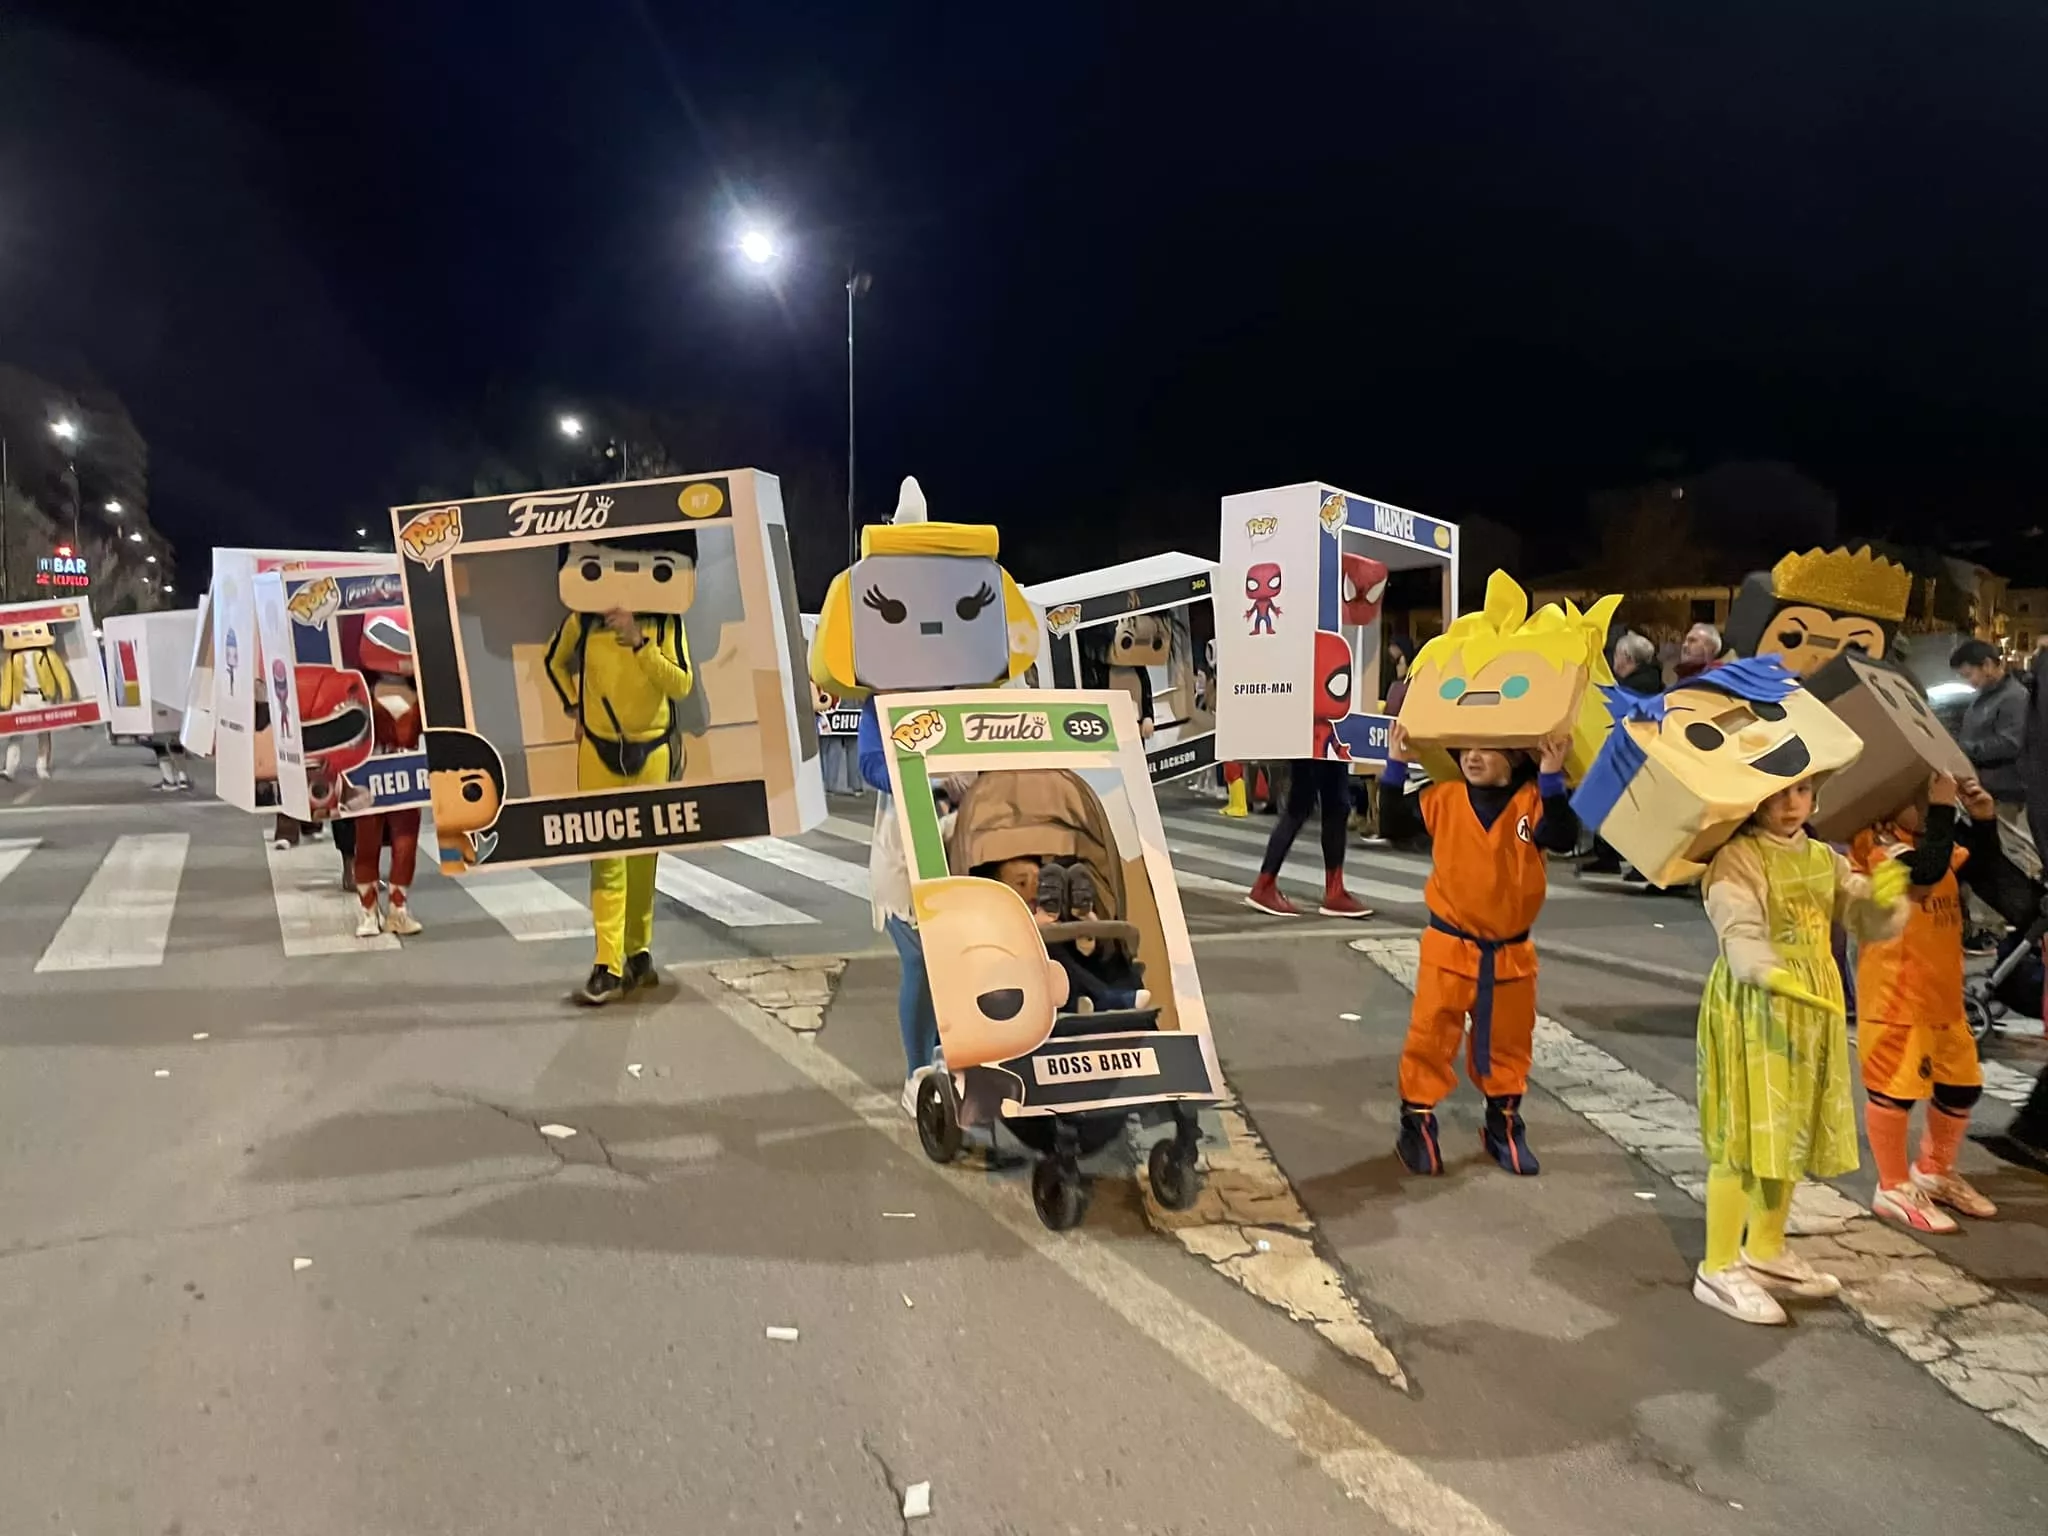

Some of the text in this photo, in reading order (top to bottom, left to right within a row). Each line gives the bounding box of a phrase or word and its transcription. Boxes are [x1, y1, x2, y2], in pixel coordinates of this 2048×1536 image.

[508, 492, 612, 537] Funko
[1247, 517, 1279, 535] POP!
[1374, 504, 1416, 541] MARVEL
[400, 508, 461, 556] POP!
[53, 557, 87, 574] BAR
[1234, 682, 1293, 695] SPIDER-MAN
[831, 714, 859, 730] CHU
[890, 708, 943, 750] POP!
[965, 713, 1047, 741] Funko
[1068, 719, 1104, 737] 395
[1368, 726, 1389, 748] SPI
[1160, 750, 1196, 770] JACKSON
[368, 770, 410, 797] RED
[543, 800, 701, 847] BRUCE LEE
[1047, 1051, 1142, 1076] BOSS BABY
